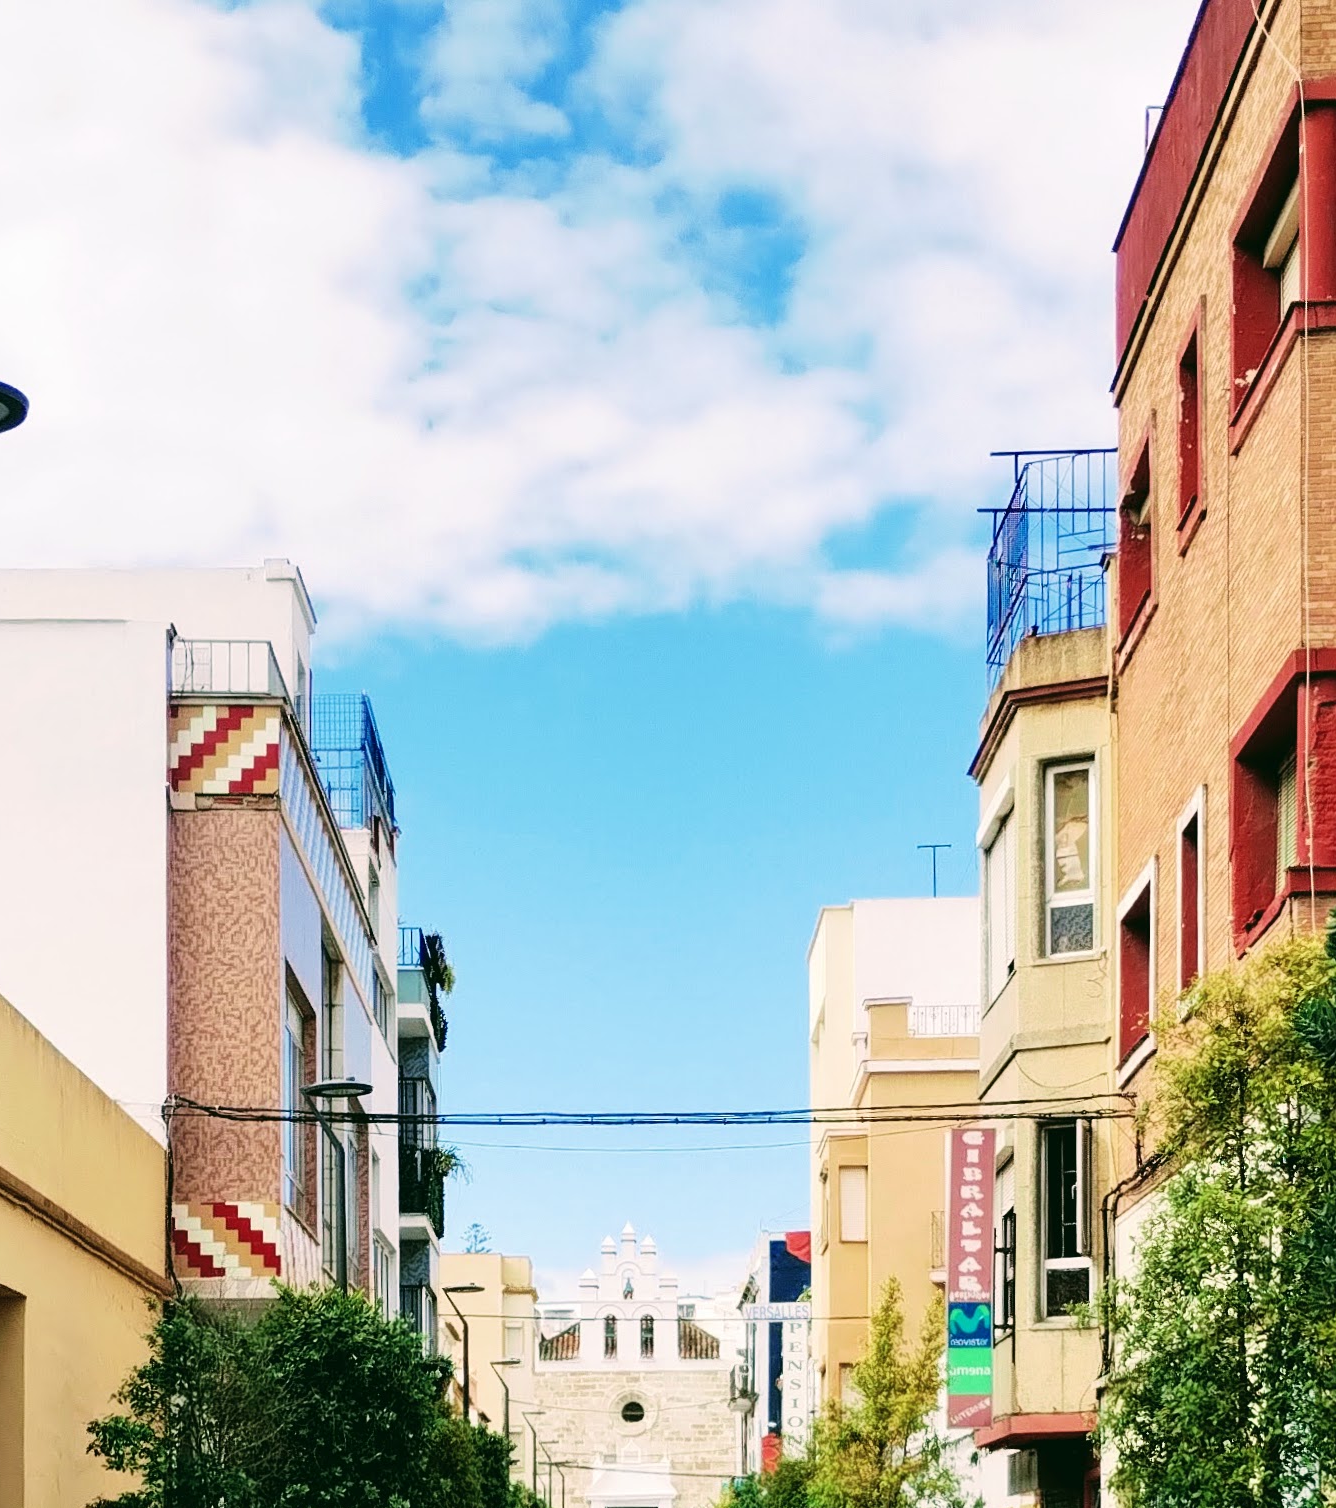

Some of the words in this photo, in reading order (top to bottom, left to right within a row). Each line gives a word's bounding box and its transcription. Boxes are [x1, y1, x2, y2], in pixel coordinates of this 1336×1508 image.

[957, 1130, 985, 1291] GIBRALTAR
[745, 1304, 810, 1320] VERSALLES
[787, 1322, 804, 1446] PENSION
